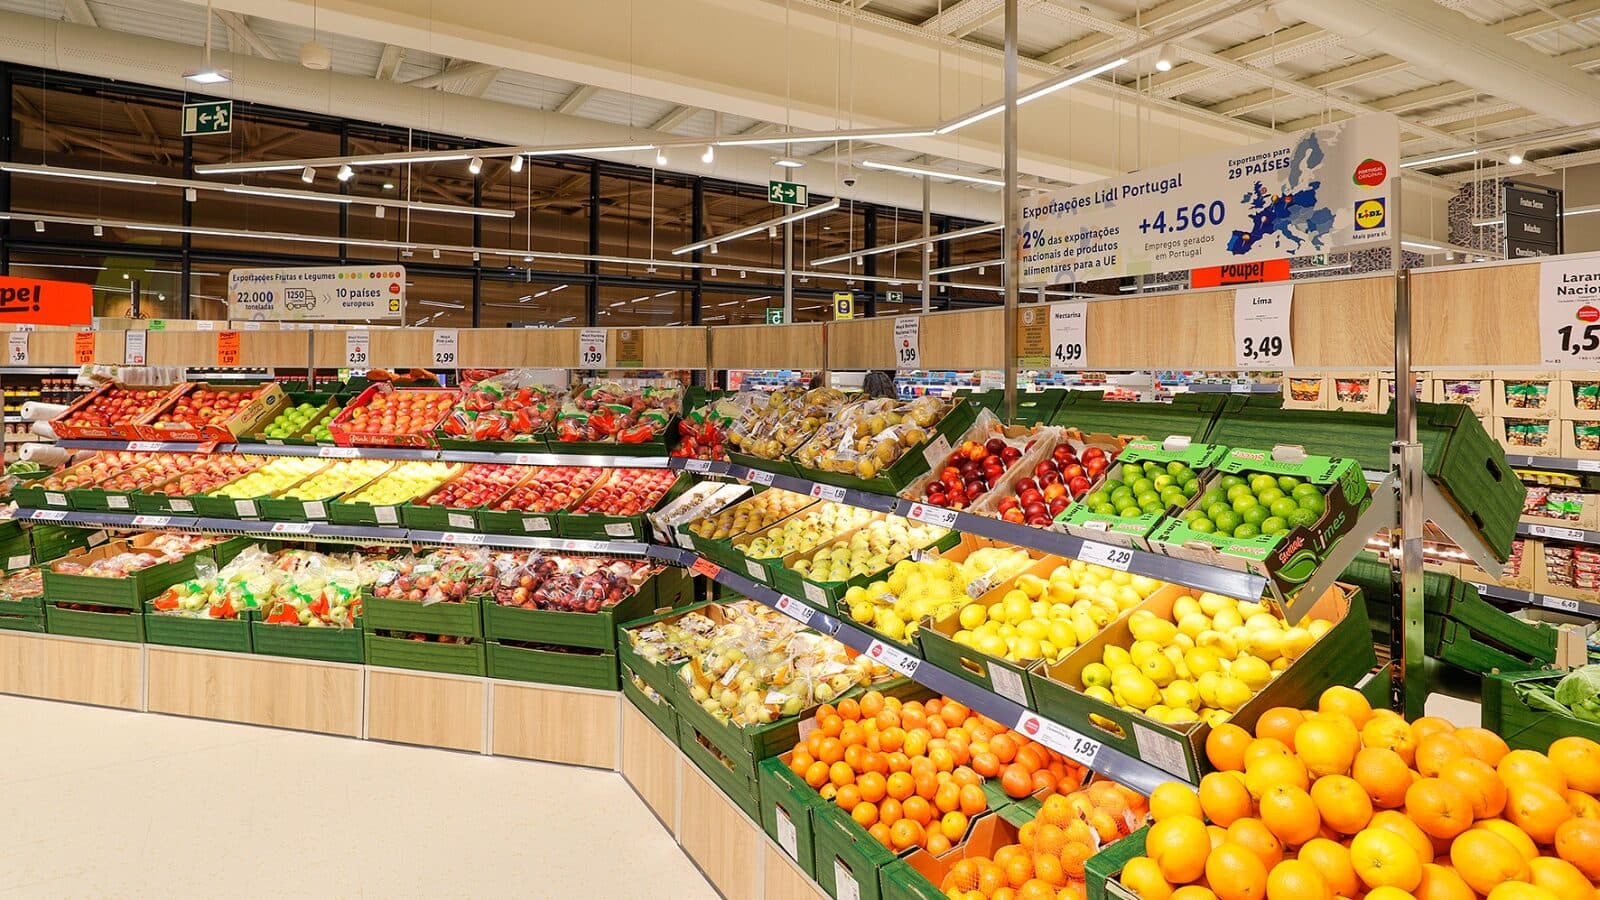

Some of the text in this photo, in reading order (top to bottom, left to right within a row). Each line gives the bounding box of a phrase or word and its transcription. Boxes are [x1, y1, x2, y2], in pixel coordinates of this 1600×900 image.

[1228, 146, 1291, 168] Exportamos para
[1228, 156, 1291, 181] 29 PAÍSES
[1022, 173, 1183, 220] Exportações Lidl Portugal
[1138, 200, 1225, 235] +4.560
[1022, 226, 1120, 249] 2% das exportações
[1144, 233, 1215, 253] Empregos gerados
[1022, 241, 1118, 263] nacionais de produtos
[1155, 246, 1202, 261] em Portugal
[1023, 255, 1117, 276] alimentares para a UE
[232, 274, 273, 284] Exportações
[275, 273, 297, 281] Frutas
[304, 273, 336, 283] Legumes
[237, 291, 273, 303] 22.000
[287, 291, 304, 299] 1250
[336, 287, 381, 300] 10 países
[342, 301, 375, 309] europeus
[1055, 312, 1082, 320] Nectarina
[899, 348, 916, 363] 1,99
[1055, 343, 1082, 362] 4,99
[1243, 336, 1283, 360] 3,49
[349, 352, 366, 364] 2,39
[436, 352, 454, 364] 2,99
[583, 352, 602, 363] 1,99
[1107, 549, 1131, 564] 2,29
[1561, 600, 1577, 608] 6,49
[900, 657, 918, 672] 2,49
[1073, 738, 1098, 757] 1,95
